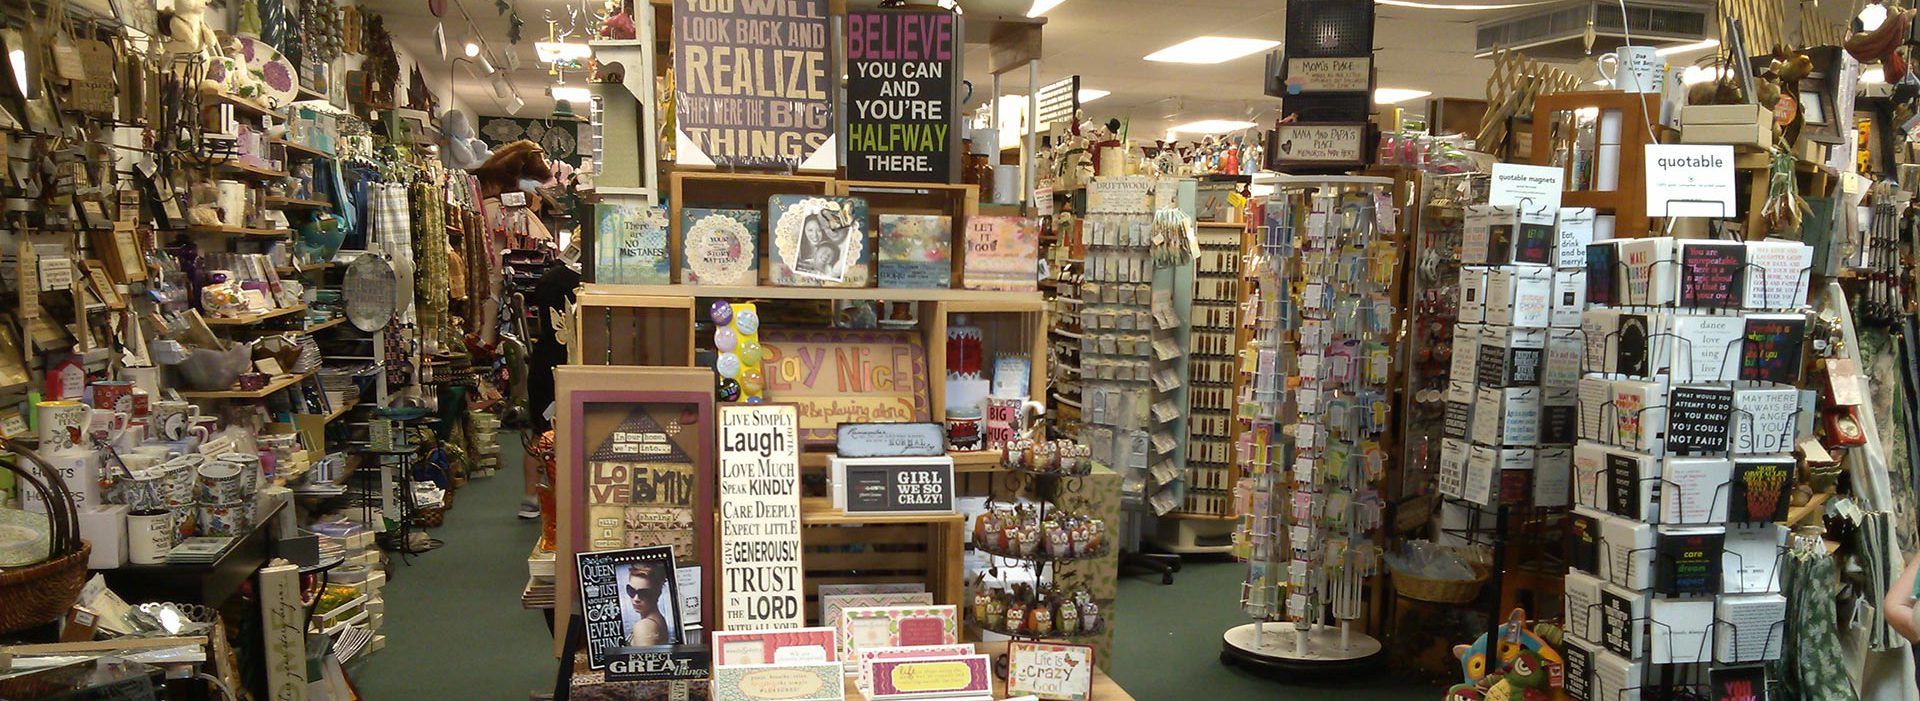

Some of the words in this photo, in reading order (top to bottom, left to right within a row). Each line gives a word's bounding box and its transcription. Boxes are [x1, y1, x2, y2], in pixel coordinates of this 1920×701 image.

[741, 0, 826, 19] WILL
[682, 16, 730, 43] LOOK
[736, 19, 783, 46] BACK
[788, 22, 826, 48] AND
[848, 14, 952, 60] BELIEVE
[685, 45, 826, 99] REALIZE
[857, 62, 896, 78] YOU
[902, 62, 942, 78] CAN
[880, 81, 920, 97] AND
[685, 98, 711, 124] THEY
[713, 99, 743, 126] WERE
[745, 101, 764, 126] THE
[770, 101, 827, 129] BIG
[856, 100, 942, 120] YOU'RE
[849, 123, 948, 152] HALFWAY
[1292, 129, 1311, 140] NANA
[685, 127, 828, 159] THINGS
[865, 155, 933, 172] THERE.
[1657, 154, 1723, 171] quotable
[1096, 182, 1148, 190] DRIFTWOOD
[1499, 174, 1527, 183] quotable
[1529, 176, 1556, 184] magnets
[624, 221, 649, 230] There
[974, 223, 993, 233] LET
[625, 240, 639, 248] NO
[980, 234, 989, 242] IT
[619, 248, 664, 257] MISTAKES
[1561, 248, 1575, 256] and
[1577, 247, 1585, 256] be
[1700, 321, 1726, 330] dance
[1702, 335, 1720, 344] love
[1701, 350, 1719, 359] sing
[1701, 364, 1717, 373] live
[1742, 394, 1762, 402] MAY
[1766, 394, 1796, 403] THERE
[990, 406, 1006, 421] BIG
[1742, 403, 1780, 411] ALWAYS
[1783, 403, 1793, 411] BE
[1684, 411, 1701, 419] YOU
[615, 432, 625, 441] In
[989, 428, 1008, 441] HUG
[1670, 435, 1691, 444] NOT
[1695, 435, 1723, 446] FAIL?
[1740, 434, 1791, 449] SIDE
[723, 427, 784, 457] Laugh
[897, 471, 942, 484] GIRL
[749, 479, 795, 495] KINDLY
[897, 484, 921, 494] WE
[923, 484, 942, 493] SO
[898, 494, 943, 504] CRAZY!
[725, 540, 733, 565] GIVE
[733, 540, 799, 563] GENEROUSLY
[582, 563, 615, 583] QUEEN
[726, 566, 798, 593] TRUST
[600, 583, 617, 597] JUST
[727, 610, 744, 619] THE
[747, 595, 798, 620] LORD
[731, 598, 740, 606] IN
[590, 620, 622, 639] EVERY
[629, 652, 673, 662] EXPECT
[1034, 652, 1052, 666] Life
[1055, 655, 1063, 667] is
[609, 658, 692, 674] GREAT
[1027, 665, 1073, 681] Crazy
[1725, 681, 1751, 695] YOU
